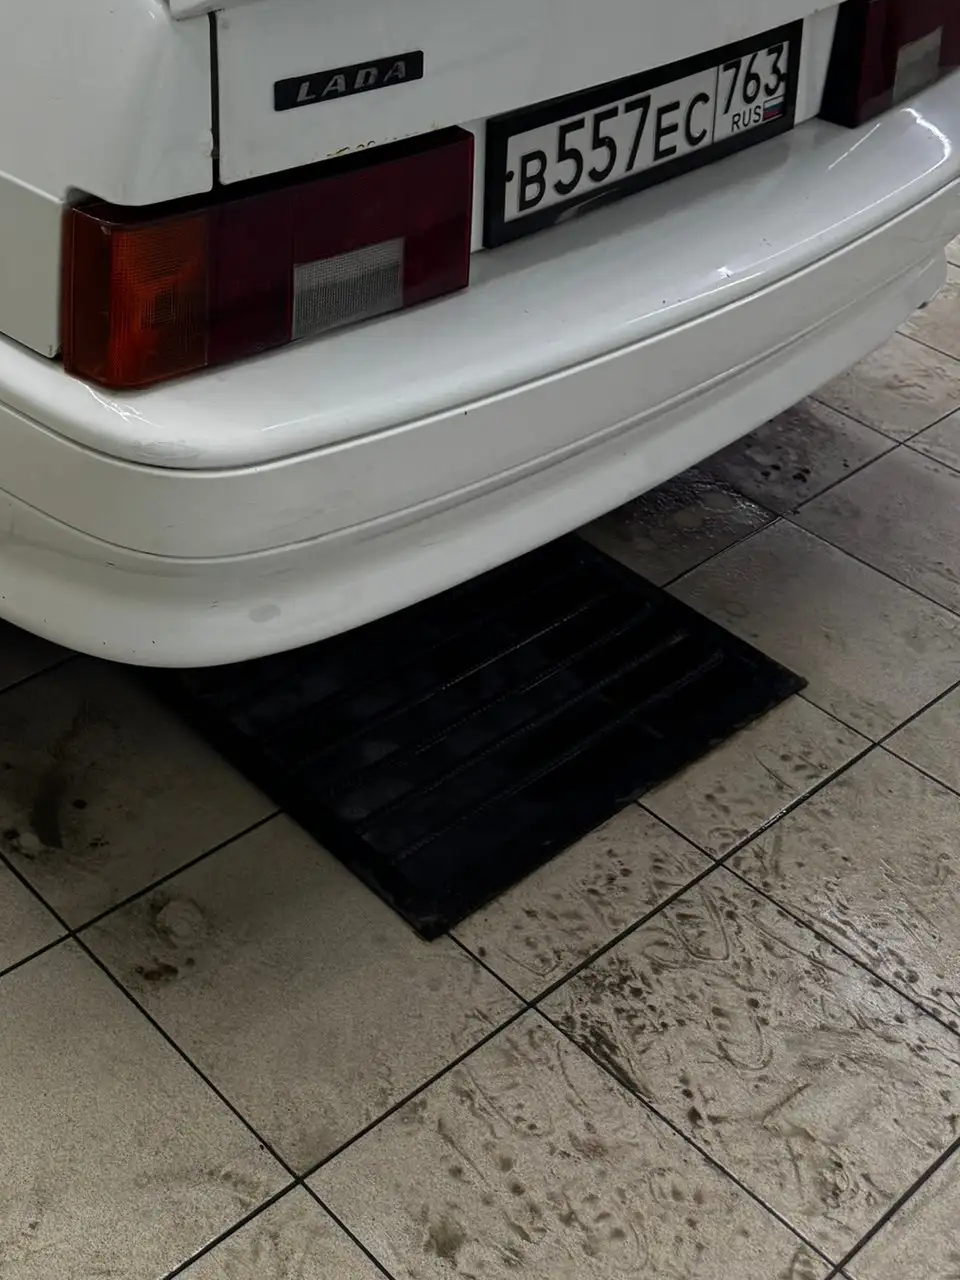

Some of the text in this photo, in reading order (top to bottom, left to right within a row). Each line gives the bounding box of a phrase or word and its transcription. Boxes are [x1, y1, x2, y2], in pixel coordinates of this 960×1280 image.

[296, 60, 407, 103] LADA
[723, 43, 784, 115] 763
[731, 105, 762, 133] RUS
